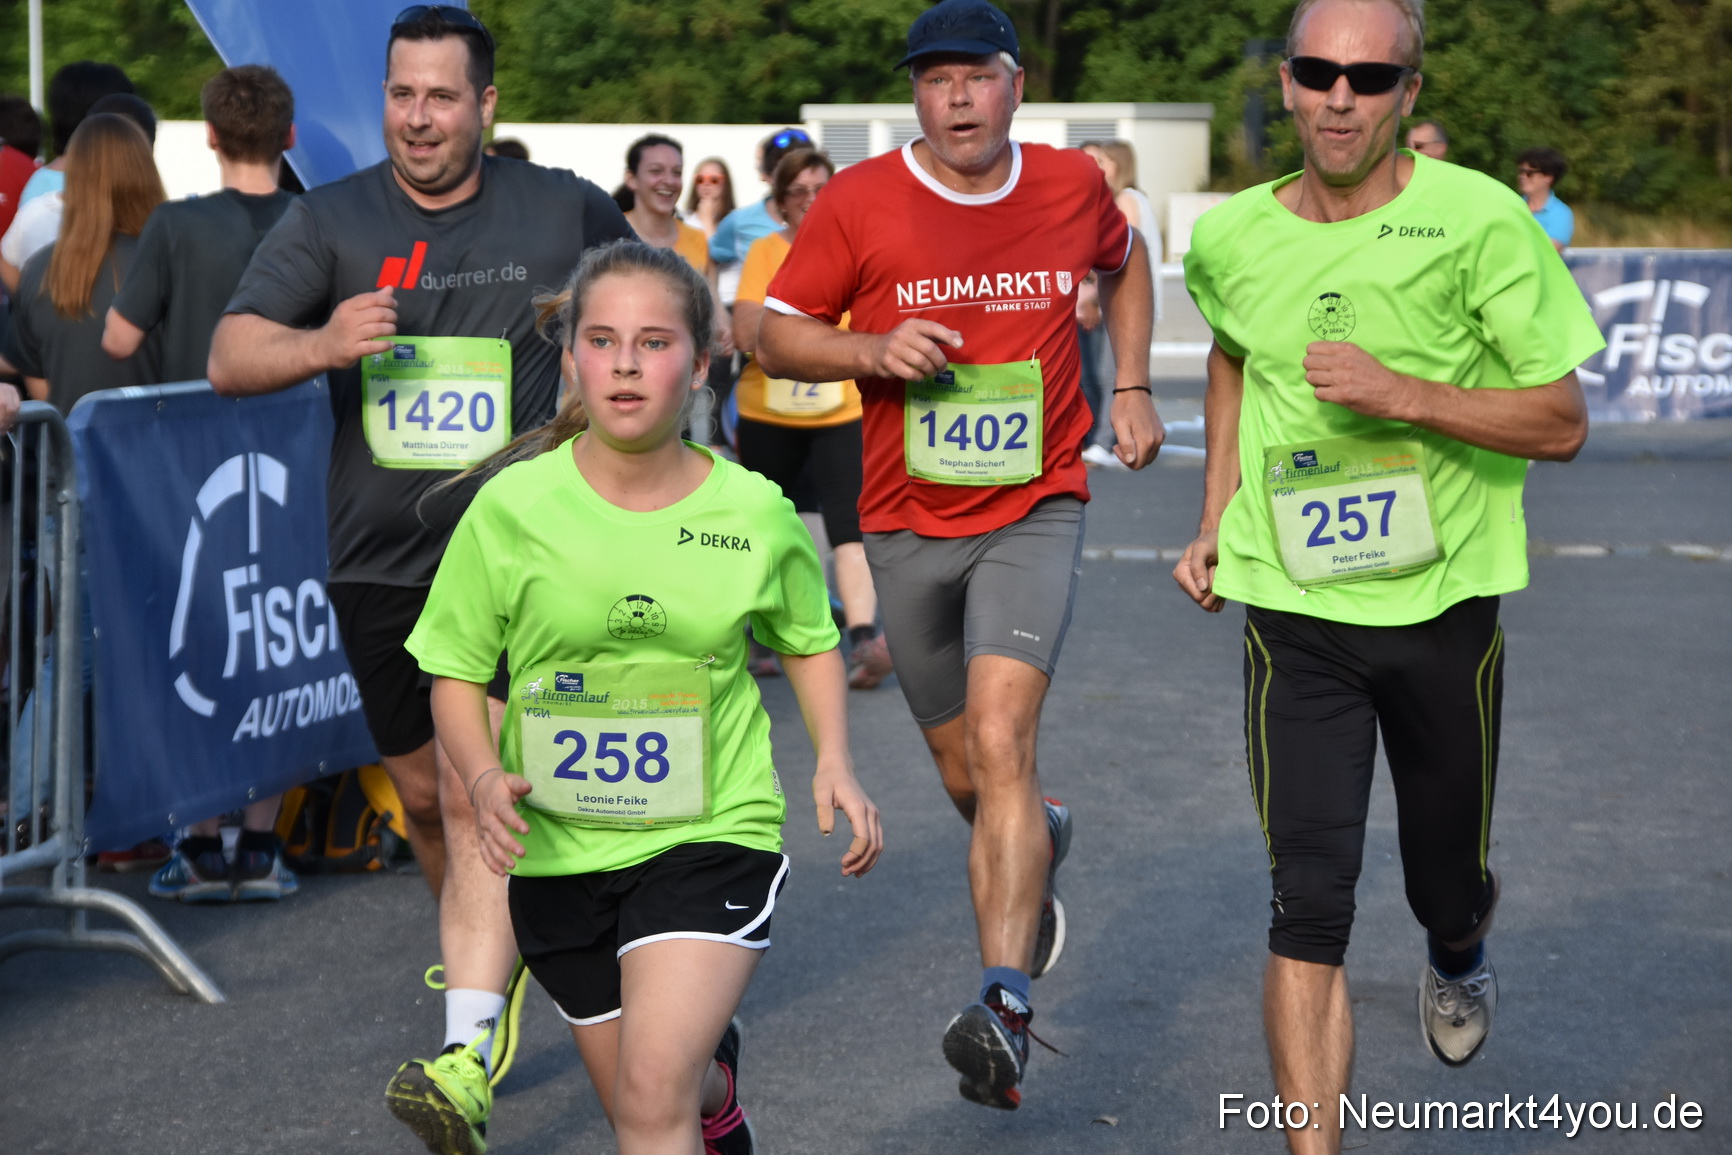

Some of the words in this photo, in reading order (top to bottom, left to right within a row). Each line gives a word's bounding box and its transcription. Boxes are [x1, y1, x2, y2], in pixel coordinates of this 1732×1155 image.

[1399, 226, 1446, 238] DEKRA
[421, 261, 527, 290] duerrer.de
[896, 271, 1050, 306] NEUMARKT
[985, 302, 1021, 313] STARKE
[1024, 301, 1051, 310] STADT
[1604, 323, 1732, 372] Fisc
[383, 358, 435, 369] firmenlauf
[437, 364, 464, 374] 2015
[975, 390, 1001, 399] 2015
[378, 390, 495, 432] 1420
[920, 409, 1028, 452] 1402
[402, 441, 438, 449] Matthias
[440, 441, 469, 449] Dürrer
[939, 458, 974, 469] Stephan
[975, 459, 1005, 468] Sichert
[1285, 460, 1341, 479] firmenlauf
[1344, 463, 1374, 476] 2015
[1301, 490, 1397, 548] 257
[701, 532, 752, 552] DEKRA
[1332, 554, 1358, 564] Peter
[1359, 550, 1386, 561] Feike
[1347, 563, 1374, 571] Automobil
[542, 688, 611, 703] firmenlauf
[612, 698, 648, 710] 2015
[553, 729, 670, 784] 258
[576, 792, 614, 805] Leonie
[616, 795, 648, 805] Feike
[577, 806, 595, 814] Dekra
